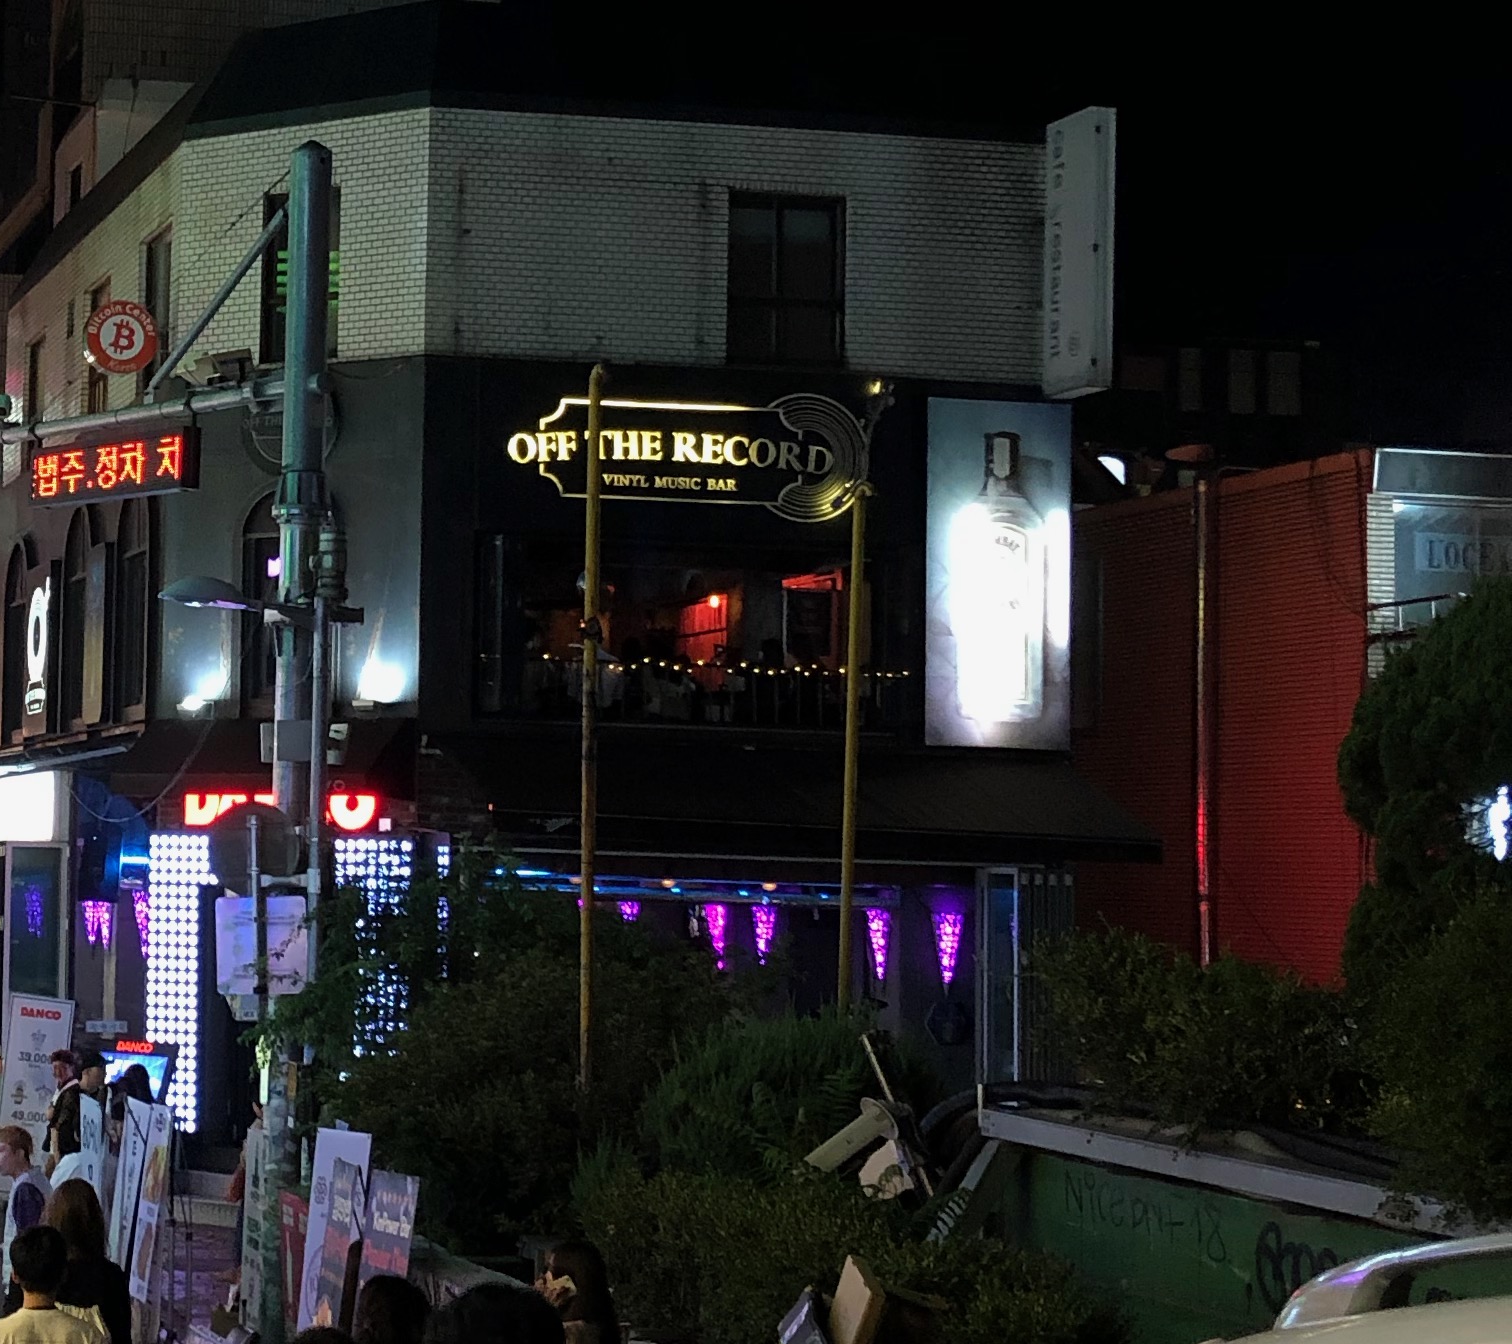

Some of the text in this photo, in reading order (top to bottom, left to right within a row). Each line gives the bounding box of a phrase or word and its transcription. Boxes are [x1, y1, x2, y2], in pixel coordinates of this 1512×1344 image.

[88, 304, 156, 337] Bitcoin Center
[507, 432, 577, 463] OFF
[671, 431, 835, 475] RECORD
[602, 473, 737, 491] VINYL MUSIC BAR
[19, 1006, 62, 1021] DANCO
[115, 1040, 154, 1054] DANCO
